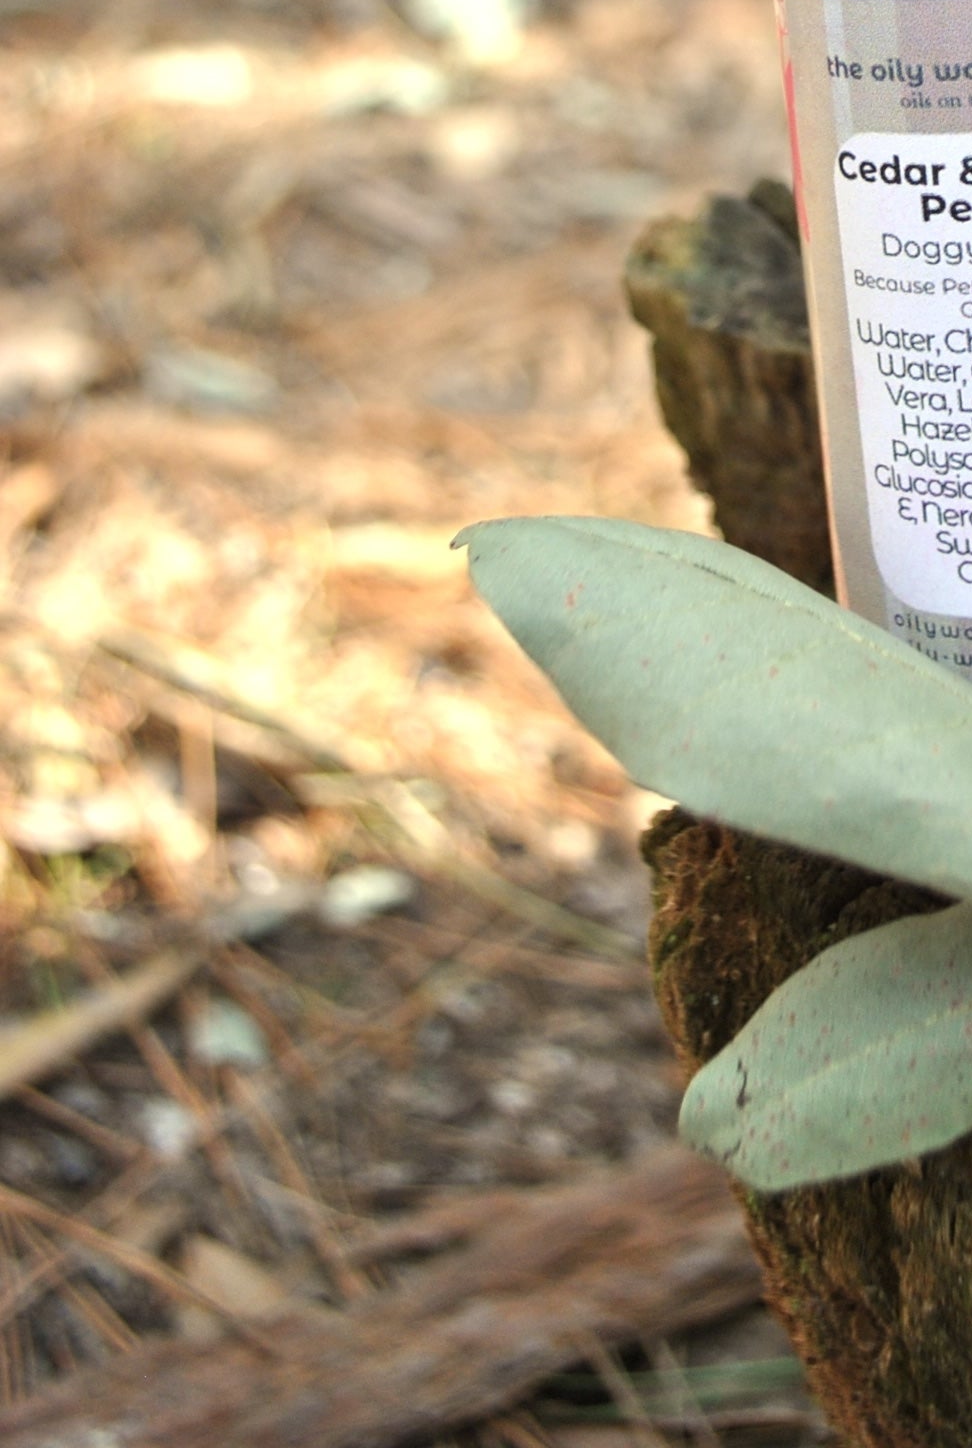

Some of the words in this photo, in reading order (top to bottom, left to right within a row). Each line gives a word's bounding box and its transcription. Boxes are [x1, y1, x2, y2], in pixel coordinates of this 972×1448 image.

[827, 55, 862, 80] the
[871, 58, 923, 87] oily
[900, 92, 931, 109] oils
[938, 95, 961, 109] on
[838, 151, 945, 185] Cedar
[853, 269, 935, 295] Because
[856, 318, 941, 357] Water,
[875, 353, 967, 386] Water,
[884, 381, 953, 415] Vera,
